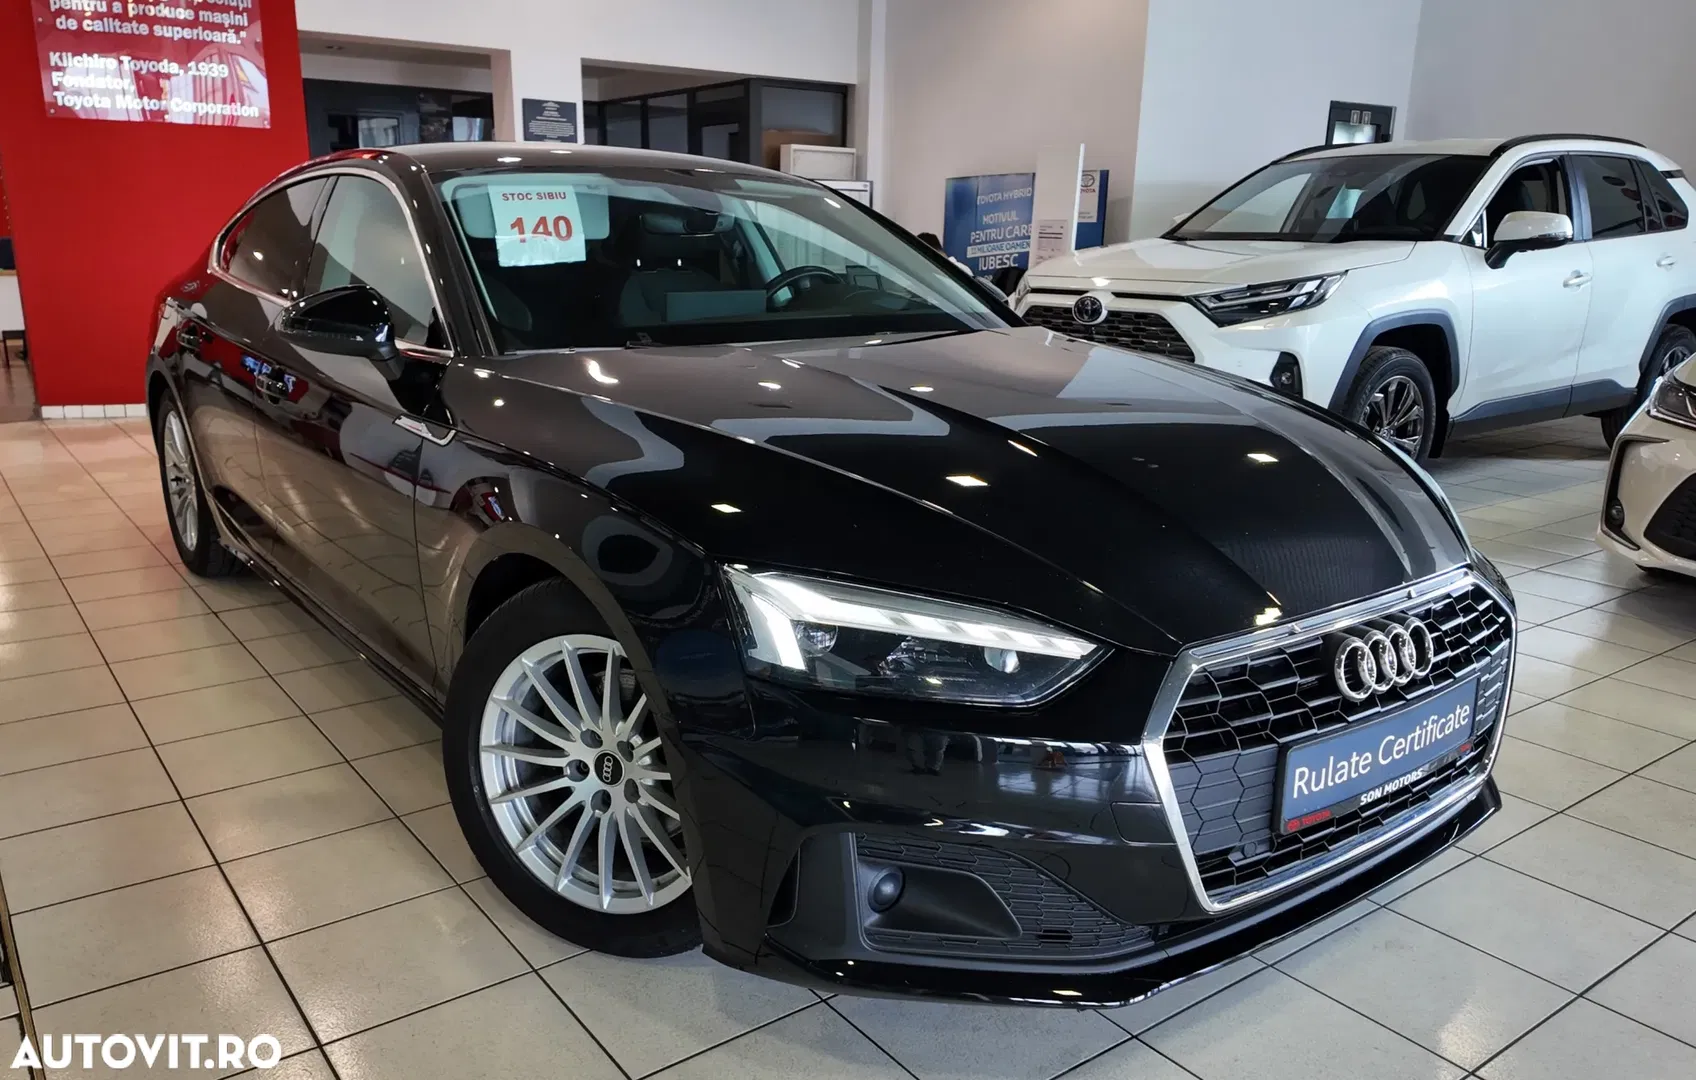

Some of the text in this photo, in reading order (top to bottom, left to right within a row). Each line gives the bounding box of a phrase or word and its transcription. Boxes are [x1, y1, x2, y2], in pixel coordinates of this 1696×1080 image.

[56, 15, 78, 30] de
[82, 17, 150, 36] calitate
[112, 2, 122, 13] a
[128, 2, 195, 20] produce
[199, 10, 248, 28] mașini
[49, 51, 229, 78] Kiichiro Toyoda, 1939
[53, 91, 259, 118] Toyota Motor Corporation
[502, 191, 567, 201] STOC SIBIU
[977, 187, 1032, 205] TOYOTA HYBRID
[510, 215, 573, 243] 140
[982, 210, 1019, 225] MOTIVUL
[970, 228, 1004, 243] PENTRU
[979, 254, 1018, 271] IUBESC
[1292, 703, 1470, 798] Rulate Certificate
[1360, 768, 1423, 806] SON MOTORS
